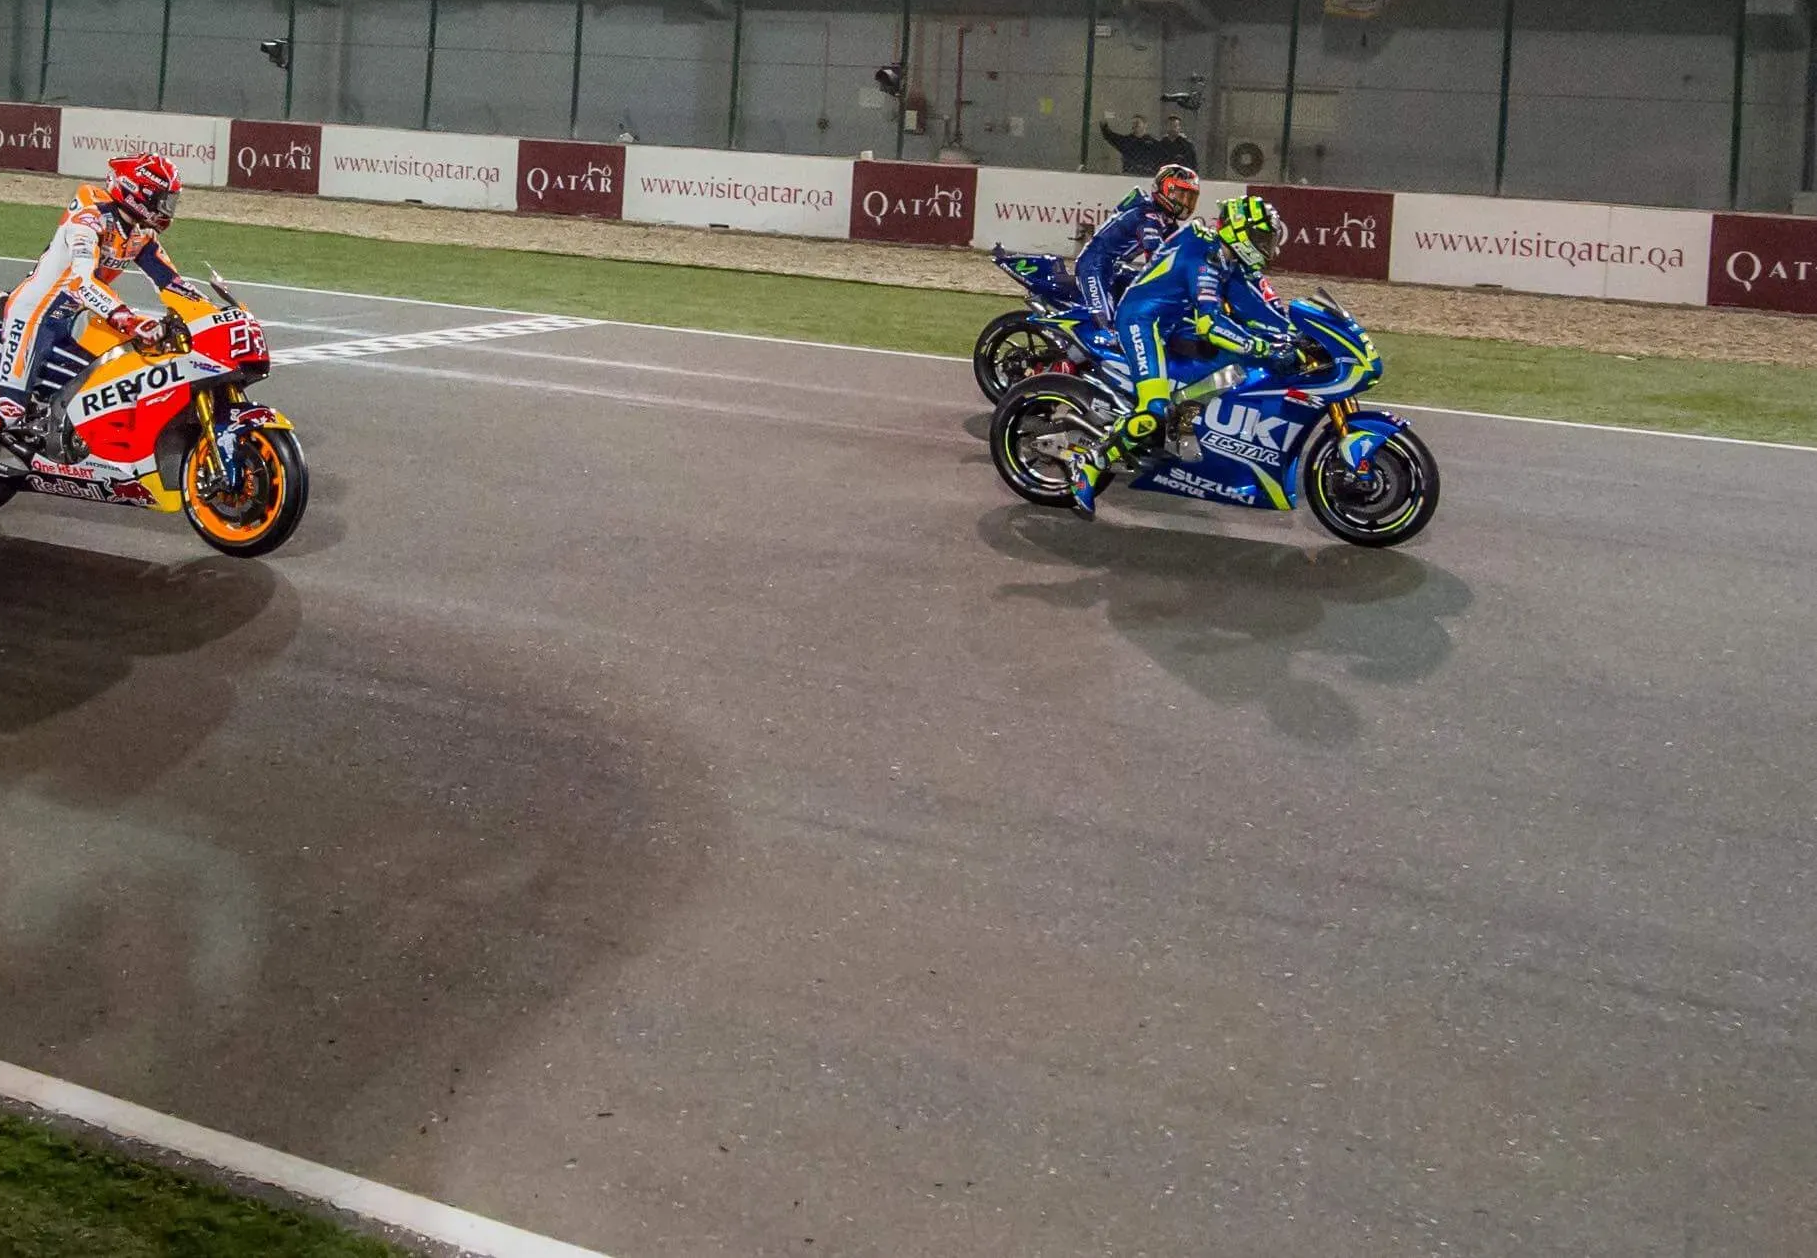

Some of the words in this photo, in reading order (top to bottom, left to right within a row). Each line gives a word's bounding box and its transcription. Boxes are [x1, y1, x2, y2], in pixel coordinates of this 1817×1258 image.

[237, 141, 313, 178] QATAR
[333, 154, 501, 188] www.visitqatar.qa
[526, 162, 613, 200] QATAR
[640, 176, 834, 212] www.visitqatar.qa
[862, 185, 964, 226] QATAR
[1414, 229, 1684, 274] www.visitqatar.qa
[1725, 250, 1817, 293] QAT
[0, 318, 26, 383] REPSOL
[1128, 324, 1150, 376] SUZUKI
[82, 360, 186, 416] REPSOL
[1200, 430, 1281, 467] ECSTAR
[1152, 472, 1205, 499] MOTUL
[1169, 467, 1256, 506] SUZUKI
